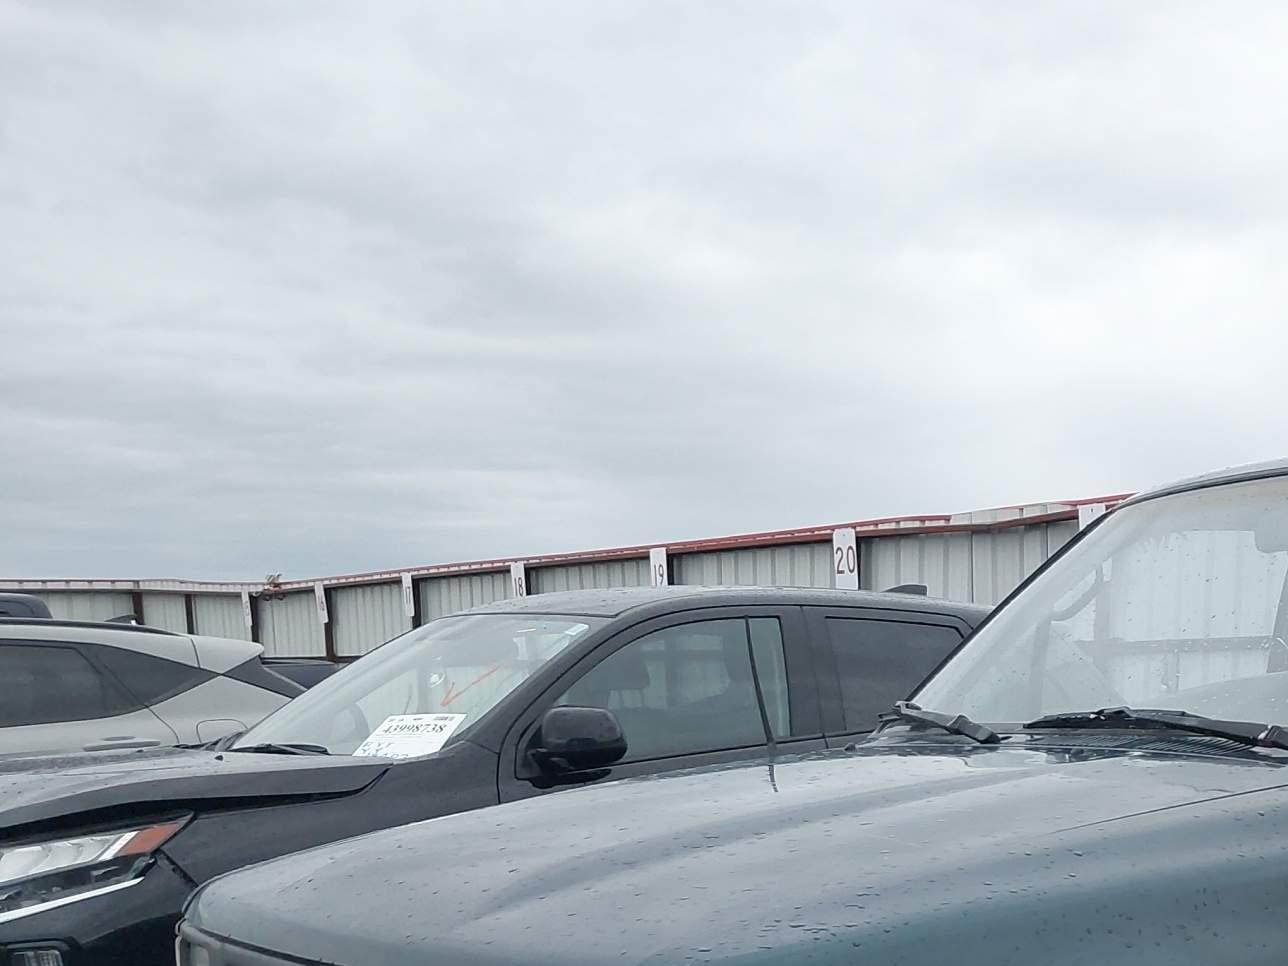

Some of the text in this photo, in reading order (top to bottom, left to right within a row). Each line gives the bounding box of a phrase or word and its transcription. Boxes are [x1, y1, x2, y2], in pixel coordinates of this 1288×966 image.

[835, 545, 856, 575] 20
[653, 563, 664, 588] 19
[514, 577, 524, 597] 18
[382, 723, 447, 734] 43998738
